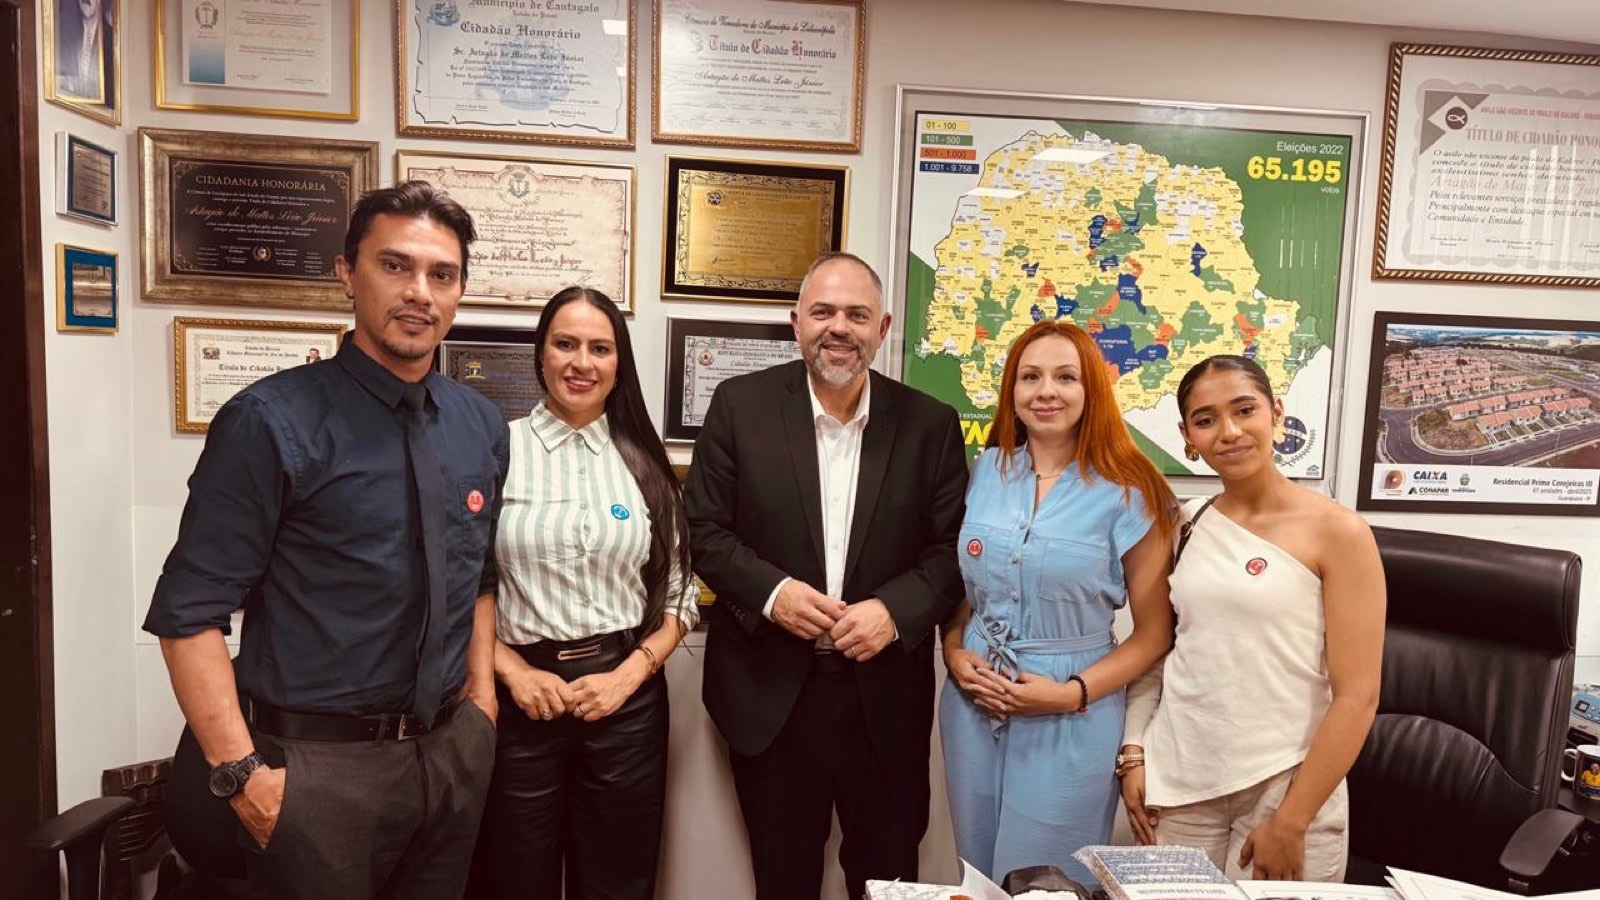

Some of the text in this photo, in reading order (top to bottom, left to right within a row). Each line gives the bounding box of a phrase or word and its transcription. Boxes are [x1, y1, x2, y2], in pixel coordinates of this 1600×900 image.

[546, 0, 600, 15] Cantagalo
[460, 21, 581, 40] Cidadão Honorário
[709, 34, 837, 60] Título de Cidadão Honorário
[925, 120, 935, 128] 01
[944, 122, 957, 130] 100
[1466, 124, 1506, 142] TÍTULO
[1506, 130, 1520, 143] DE
[1522, 130, 1567, 146] CIDADÃO
[946, 136, 960, 145] 500
[1276, 141, 1344, 156] Eleições 2022
[947, 150, 966, 158] 1.000
[950, 164, 972, 172] 9.758
[1247, 154, 1342, 184] 65.195
[196, 175, 326, 192] CIDADANIA HONORÁRIA
[1484, 178, 1498, 190] de
[1320, 186, 1340, 195] votos
[1495, 195, 1525, 204] serviços
[1428, 201, 1491, 212] Principalmente
[1427, 212, 1480, 222] Comunidade
[1413, 471, 1447, 480] CAIXA
[1494, 478, 1530, 486] Residencial
[1531, 479, 1550, 487] Prime
